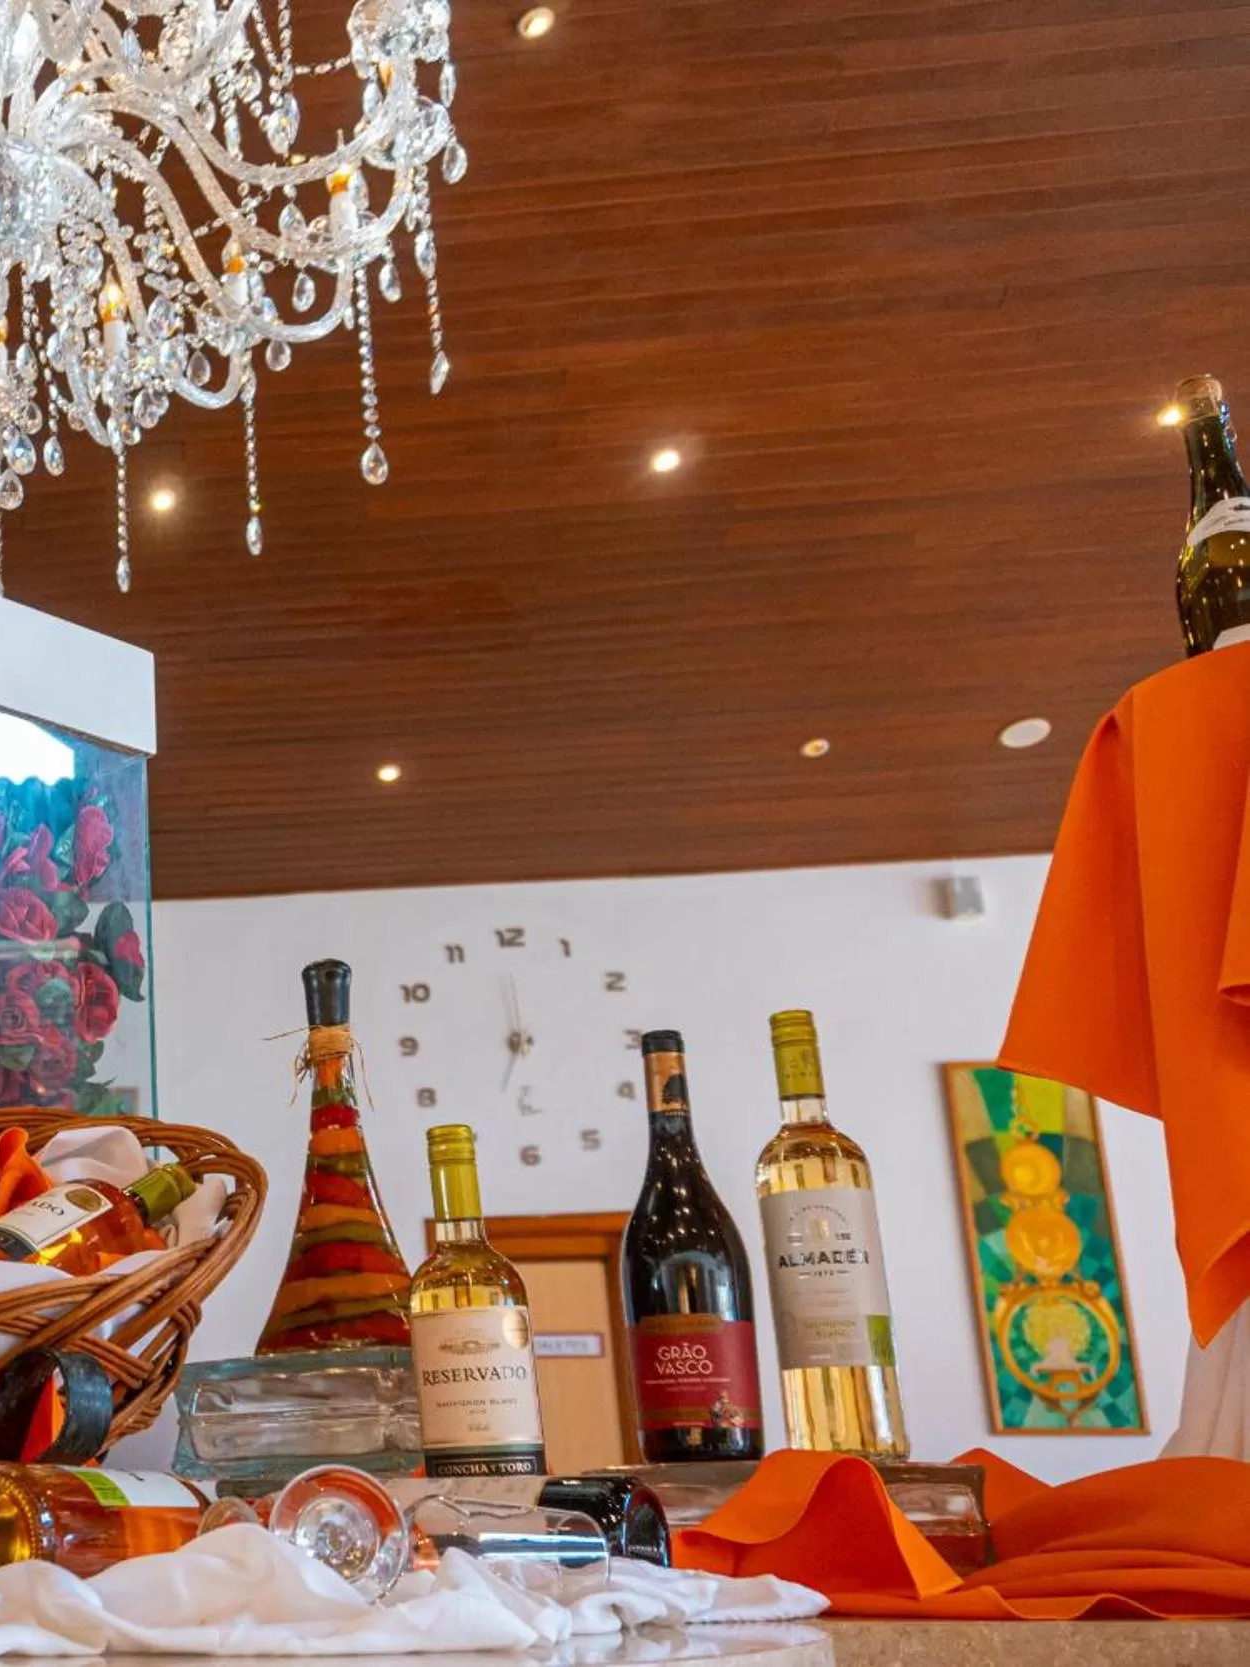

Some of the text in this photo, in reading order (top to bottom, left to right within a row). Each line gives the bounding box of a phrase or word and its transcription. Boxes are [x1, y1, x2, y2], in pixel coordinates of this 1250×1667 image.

[494, 927, 526, 948] 12
[559, 937, 572, 958] 1
[444, 943, 466, 964] 11
[604, 971, 627, 992] 2
[399, 982, 431, 1003] 10
[398, 1036, 420, 1057] 9
[623, 1029, 643, 1050] 3
[416, 1087, 437, 1108] 8
[580, 1129, 601, 1150] 5
[519, 1145, 541, 1166] 6
[657, 1341, 708, 1360] GRÃO
[422, 1366, 527, 1387] RESERVADO
[655, 1360, 714, 1375] VASCO
[437, 1463, 488, 1476] CONCHA
[499, 1461, 532, 1474] TORO
